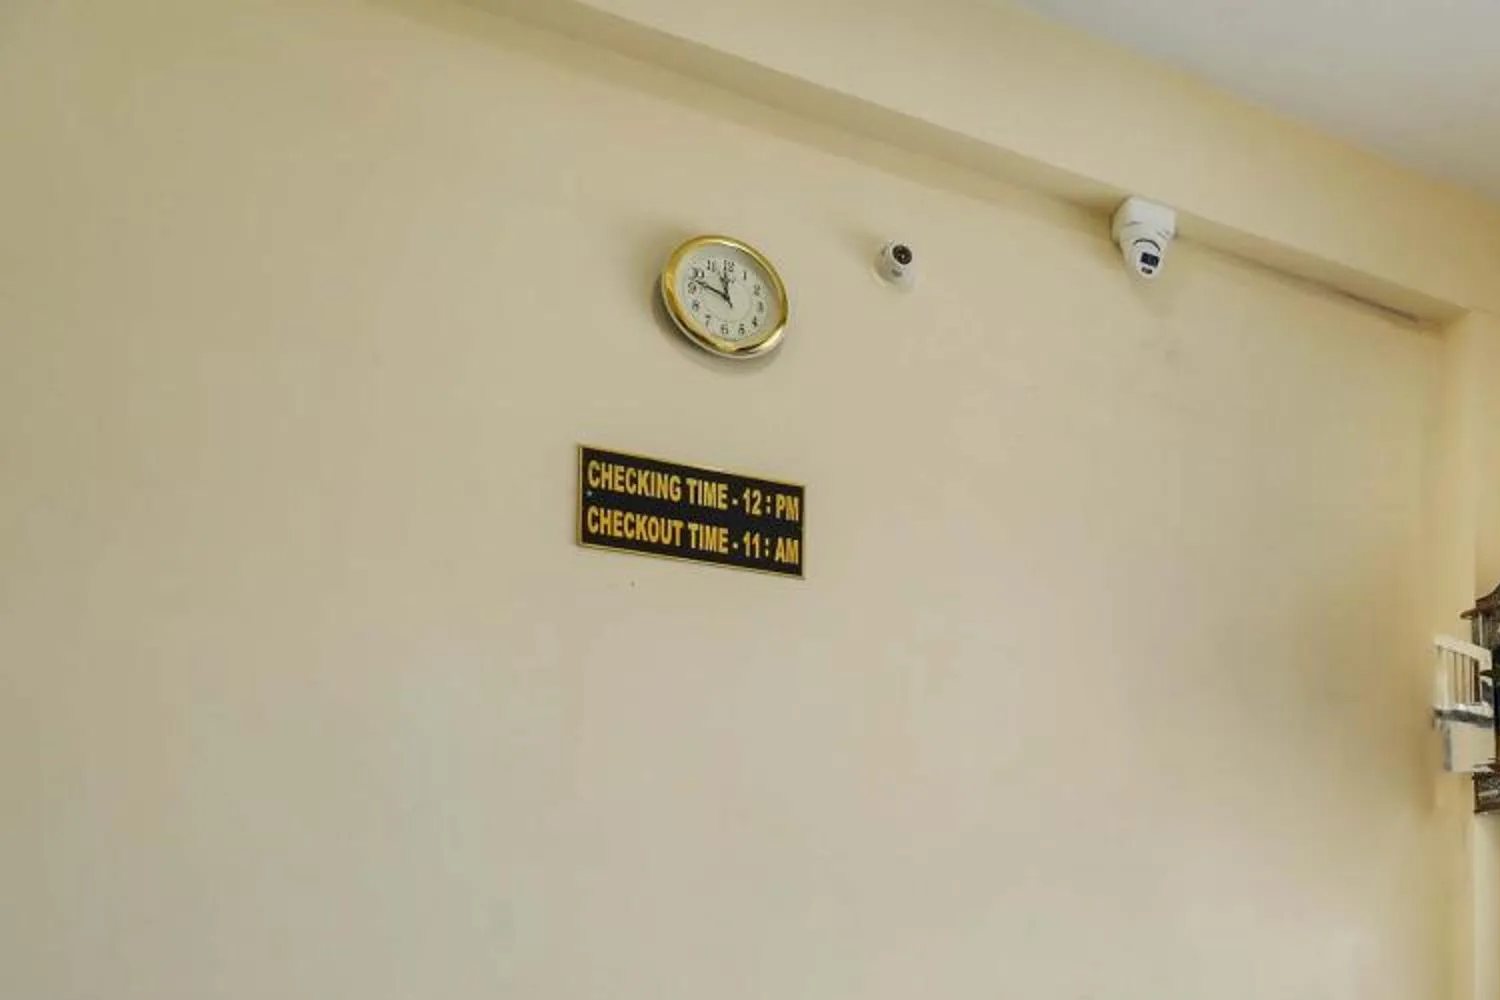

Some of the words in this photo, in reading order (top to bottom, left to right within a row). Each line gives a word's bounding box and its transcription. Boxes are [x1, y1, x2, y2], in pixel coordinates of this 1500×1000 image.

[588, 460, 681, 502] CHECKING
[686, 479, 728, 510] TIME
[587, 506, 683, 547] CHECKOUT
[687, 523, 728, 554] TIME
